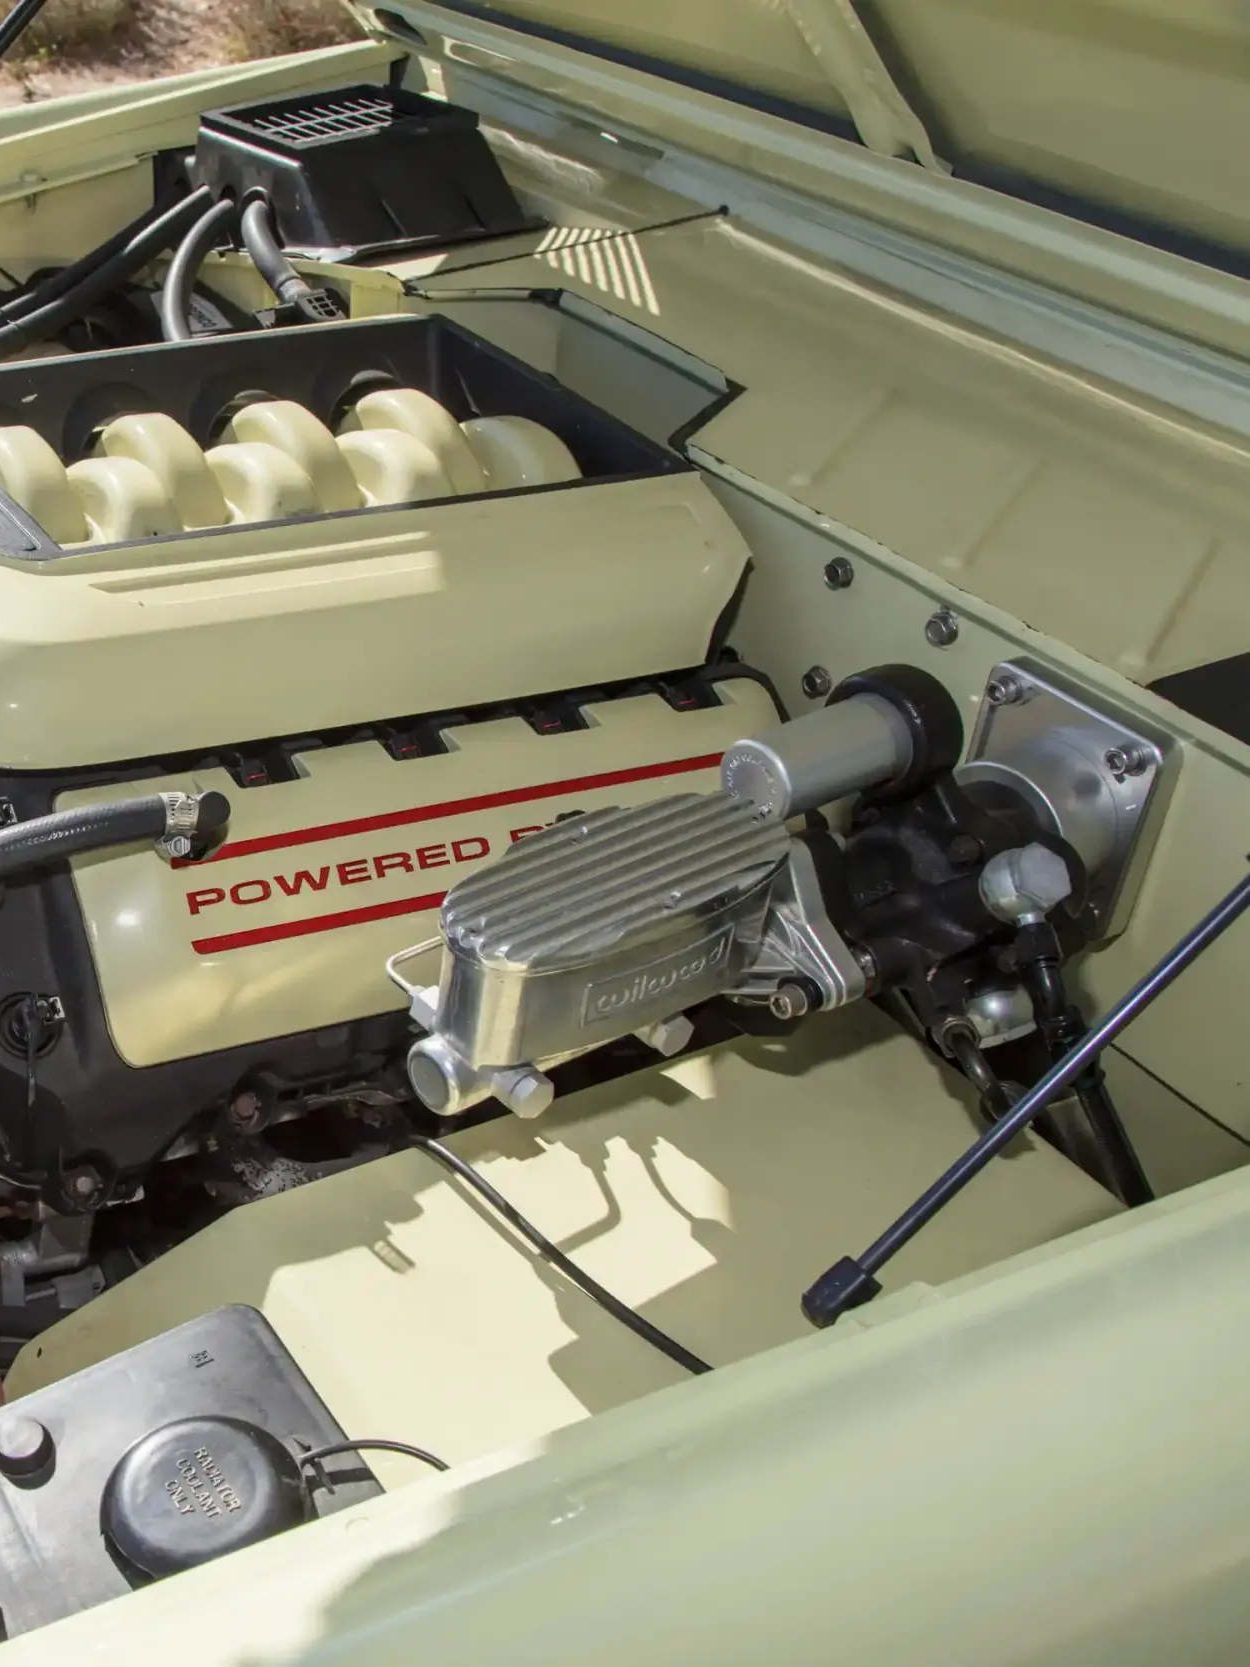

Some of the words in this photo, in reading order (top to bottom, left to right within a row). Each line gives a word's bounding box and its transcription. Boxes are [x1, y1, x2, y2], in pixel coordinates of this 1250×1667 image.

[186, 836, 490, 915] POWERED
[597, 936, 726, 1011] wilwood
[165, 1480, 195, 1514] ONLY
[176, 1459, 222, 1517] COOLANT
[194, 1446, 241, 1512] RADIATOR
